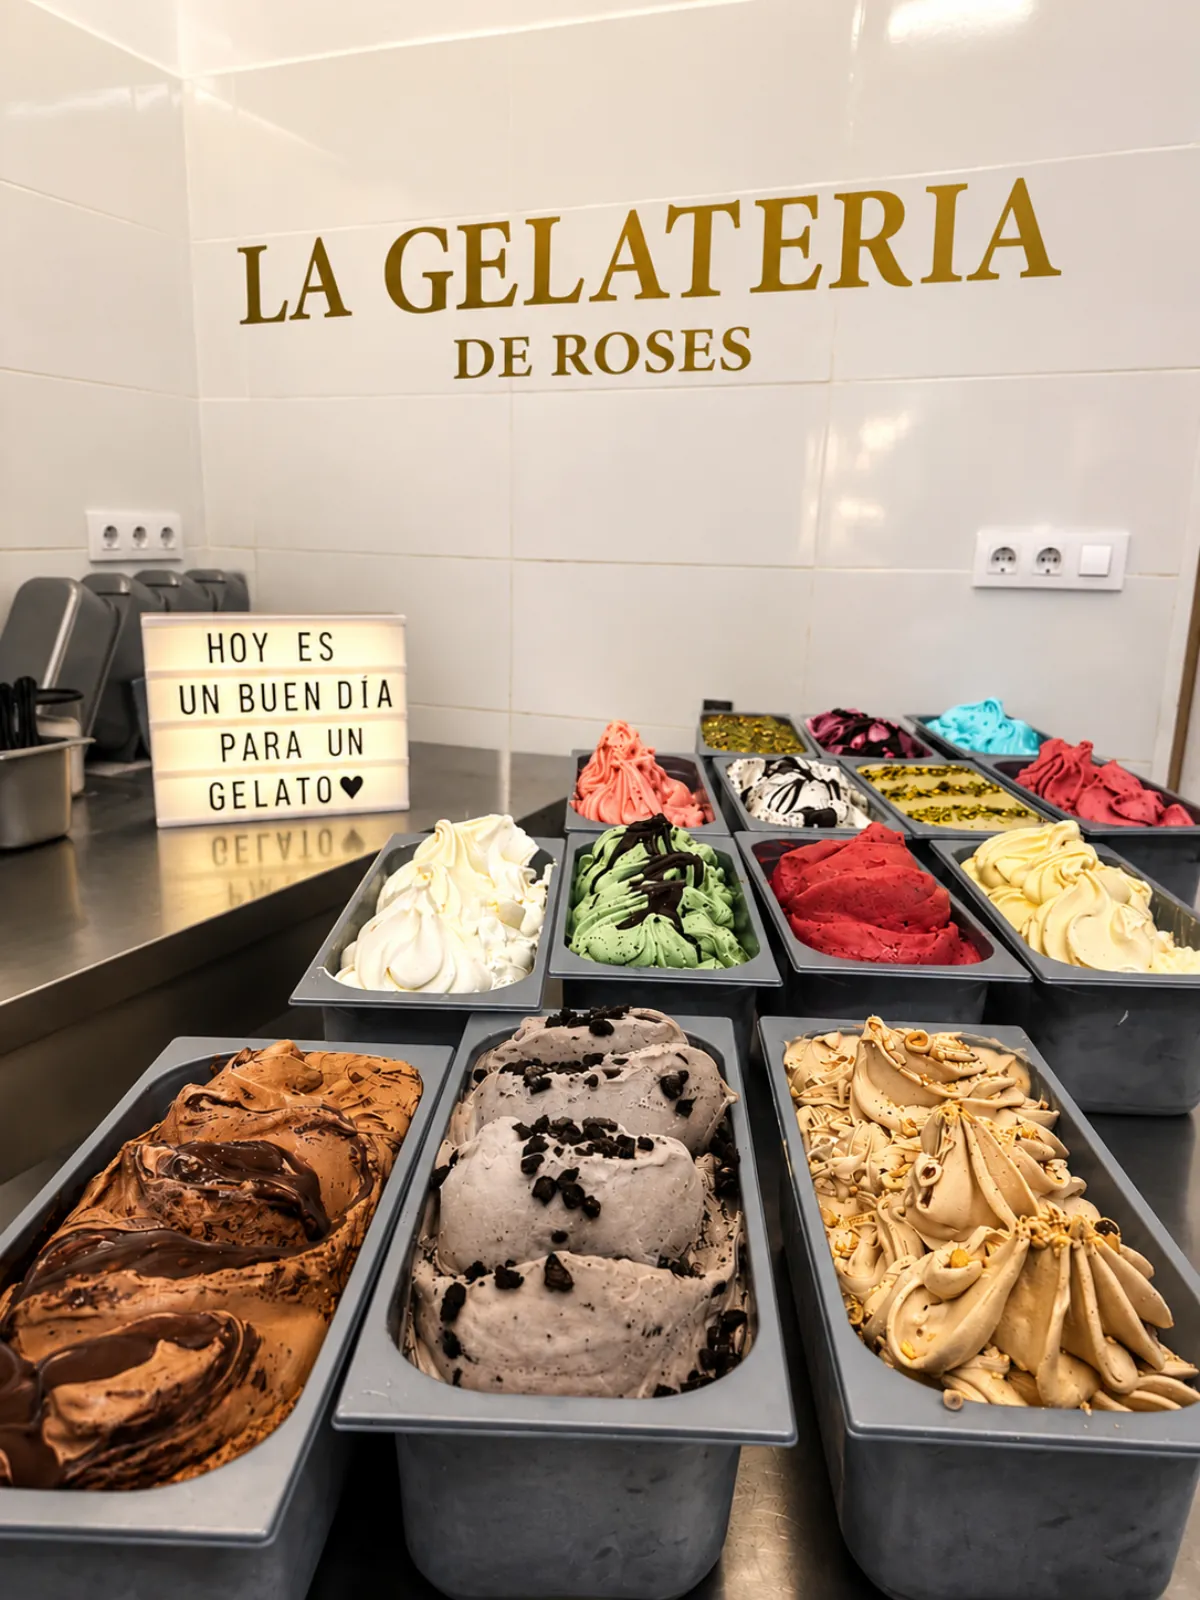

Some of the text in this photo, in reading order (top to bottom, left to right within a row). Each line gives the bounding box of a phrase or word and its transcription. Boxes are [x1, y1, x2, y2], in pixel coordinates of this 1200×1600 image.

[236, 177, 1062, 326] LA GELATERIA
[453, 326, 752, 380] DE ROSES
[207, 631, 334, 664] HOY ES
[179, 675, 393, 716] UN BUEN DÍA
[220, 727, 363, 763] PARA UN
[209, 775, 332, 811] GELATO
